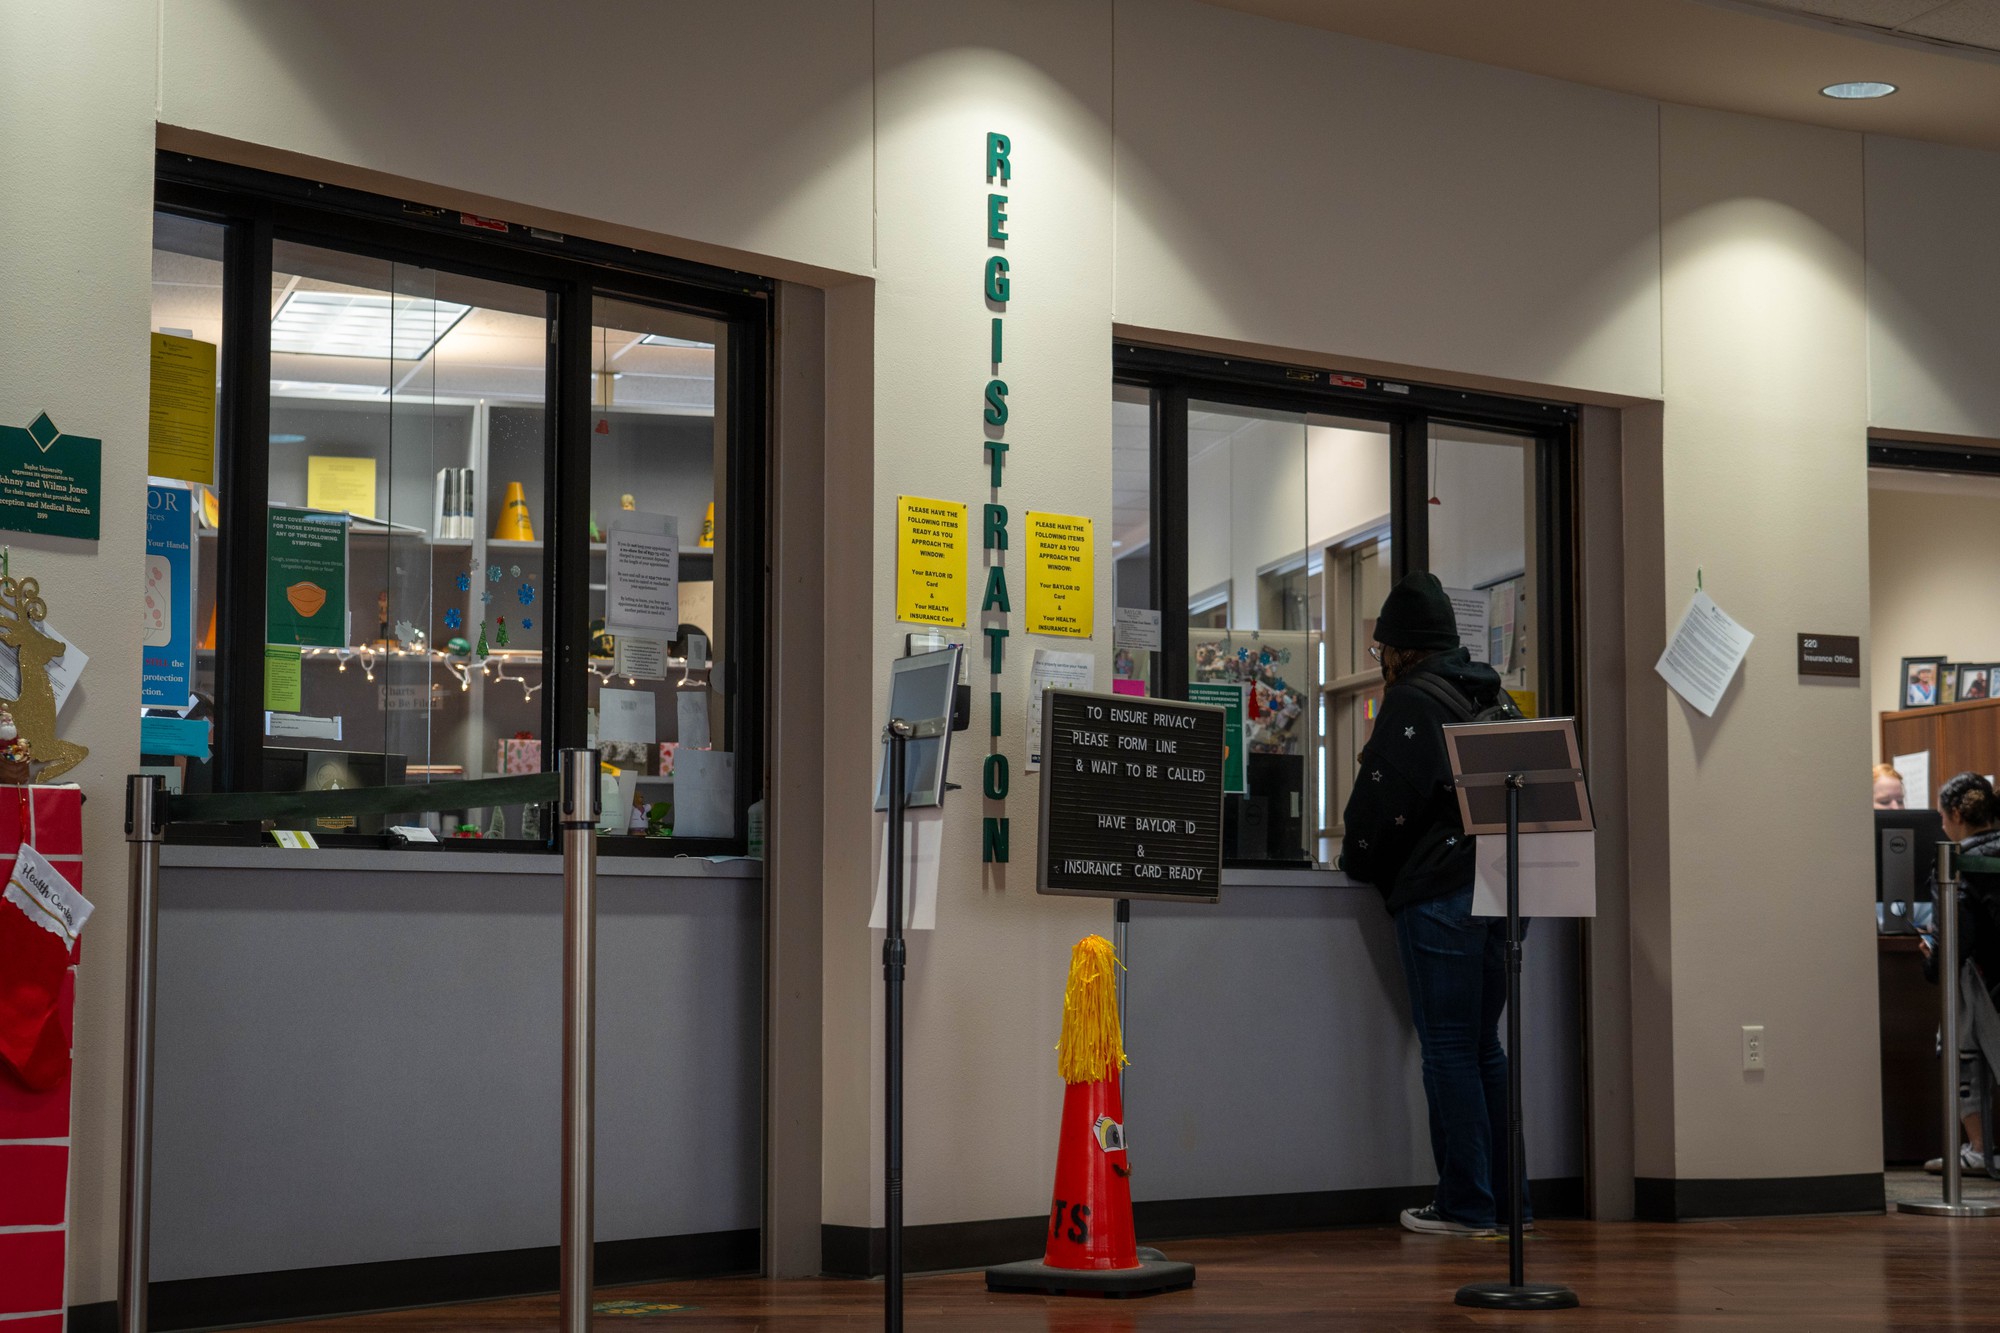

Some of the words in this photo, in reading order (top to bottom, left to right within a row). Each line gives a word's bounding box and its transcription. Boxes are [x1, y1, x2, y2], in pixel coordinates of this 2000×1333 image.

[26, 480, 40, 488] and
[43, 480, 66, 492] Wilma
[69, 484, 88, 494] Jones
[982, 131, 1011, 863] REGISTRATION
[40, 501, 64, 512] Medical
[66, 504, 90, 514] Records
[908, 506, 929, 514] PLEASE
[930, 508, 946, 516] HAVE
[946, 510, 958, 518] THE
[908, 516, 940, 526] FOLLOWING
[941, 520, 958, 528] ITEMS
[304, 526, 341, 534] EXPERIENCING
[1035, 532, 1066, 540] FOLLOWING
[147, 538, 164, 548] Your
[166, 541, 189, 550] Hands
[912, 539, 942, 547] APPROACH
[920, 550, 945, 558] WINDOW:
[1047, 564, 1072, 572] WINDOW:
[928, 604, 949, 612] HEALTH
[910, 613, 940, 621] INSURANCE
[1038, 624, 1068, 632] INSURANCE
[1804, 639, 1818, 648] 220
[172, 659, 184, 668] the
[1804, 654, 1832, 662] Insurance
[1834, 655, 1853, 664] Office
[143, 674, 184, 682] protection
[382, 686, 416, 696] Charts
[1087, 706, 1102, 720] TO
[1110, 708, 1148, 725] ENSURE
[1153, 713, 1197, 730] PRIVACY
[1072, 732, 1109, 748] PLEASE
[1118, 736, 1147, 751] FORM
[1155, 740, 1177, 754] LINE
[1076, 759, 1084, 772] &
[1091, 760, 1118, 775] WAIT
[1126, 763, 1140, 777] TO
[1146, 765, 1158, 779] BE
[1167, 767, 1206, 782] CALLED
[1098, 816, 1126, 830] HAVE
[1136, 818, 1176, 833] BAYLOR
[1185, 820, 1196, 834] ID
[1137, 845, 1145, 858] &
[1064, 861, 1122, 876] INSURANCE
[1134, 864, 1162, 878] CARD
[1169, 866, 1202, 881] READY
[22, 862, 50, 899] Health
[50, 894, 74, 926] Center
